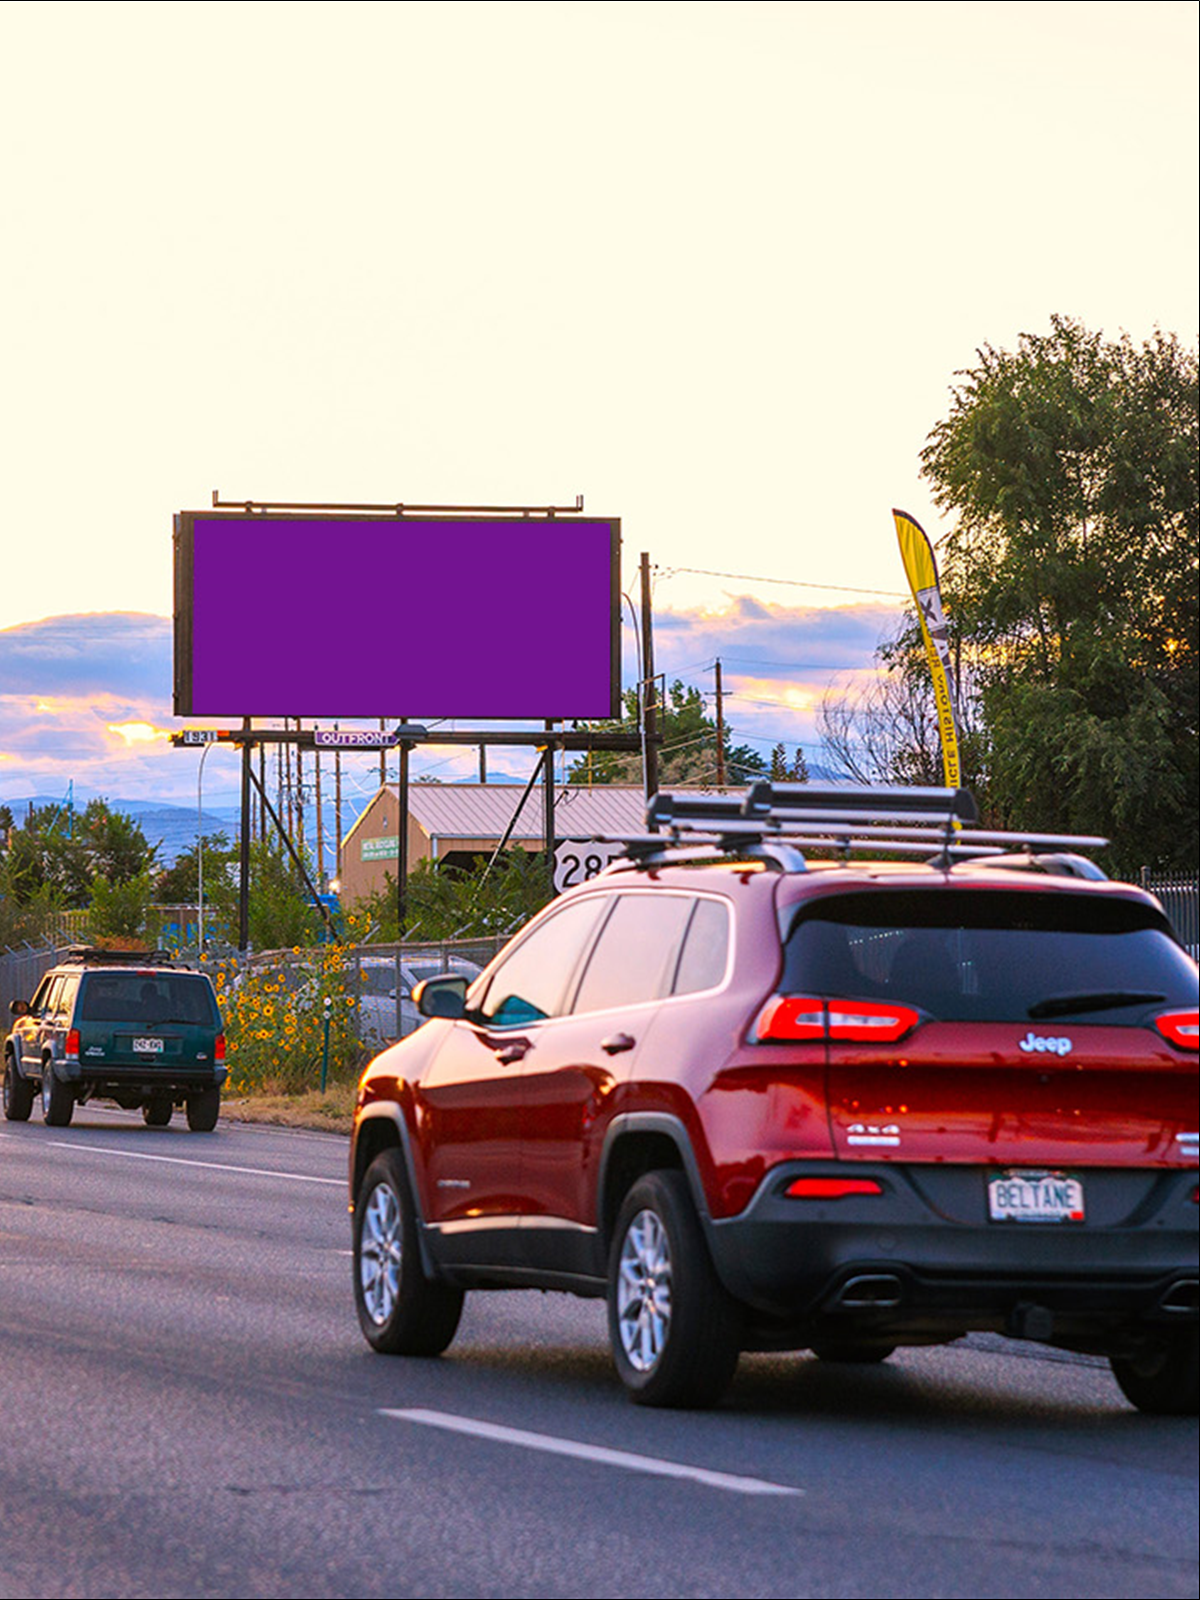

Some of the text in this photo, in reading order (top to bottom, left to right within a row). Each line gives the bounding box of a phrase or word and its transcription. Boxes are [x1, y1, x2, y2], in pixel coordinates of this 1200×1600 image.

[321, 732, 390, 744] OUTFRONT
[1019, 1033, 1072, 1055] Jeep
[996, 1183, 1075, 1209] BELTANE
